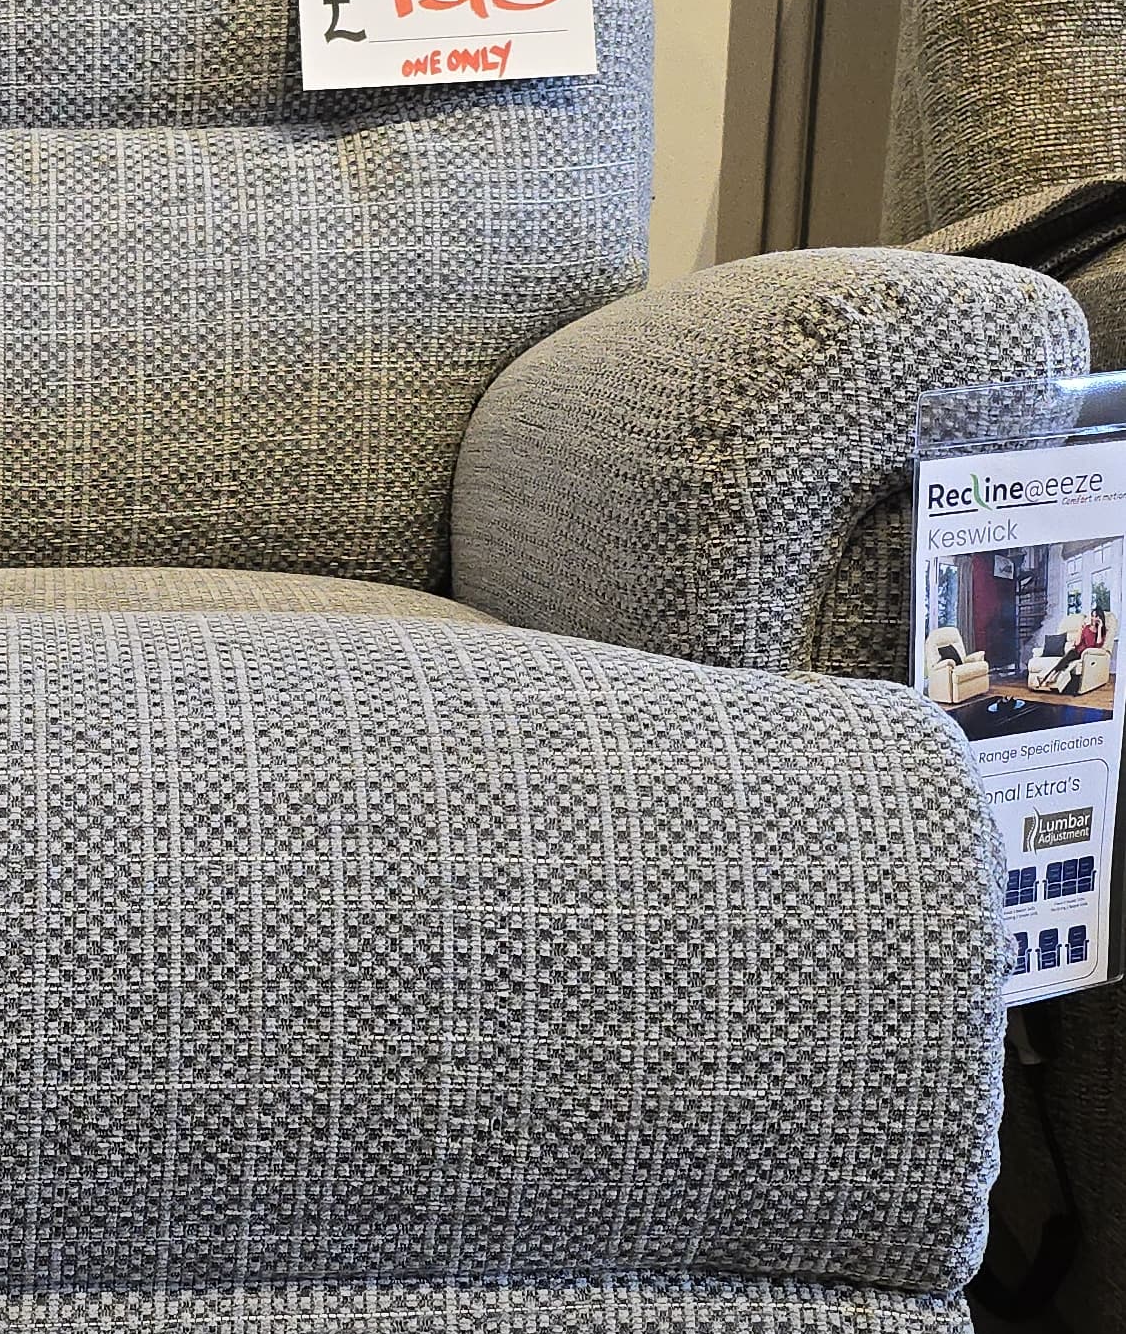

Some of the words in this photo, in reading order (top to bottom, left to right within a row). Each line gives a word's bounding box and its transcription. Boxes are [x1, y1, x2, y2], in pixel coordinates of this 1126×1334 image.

[401, 50, 442, 77] ONE
[447, 40, 512, 78] ONLY
[929, 519, 1018, 550] Keswick
[978, 749, 1017, 764] Range
[1020, 735, 1104, 759] Specifications
[1026, 776, 1081, 799] Extra's
[1038, 813, 1090, 834] Lumbar
[1038, 827, 1090, 845] Adjustment
